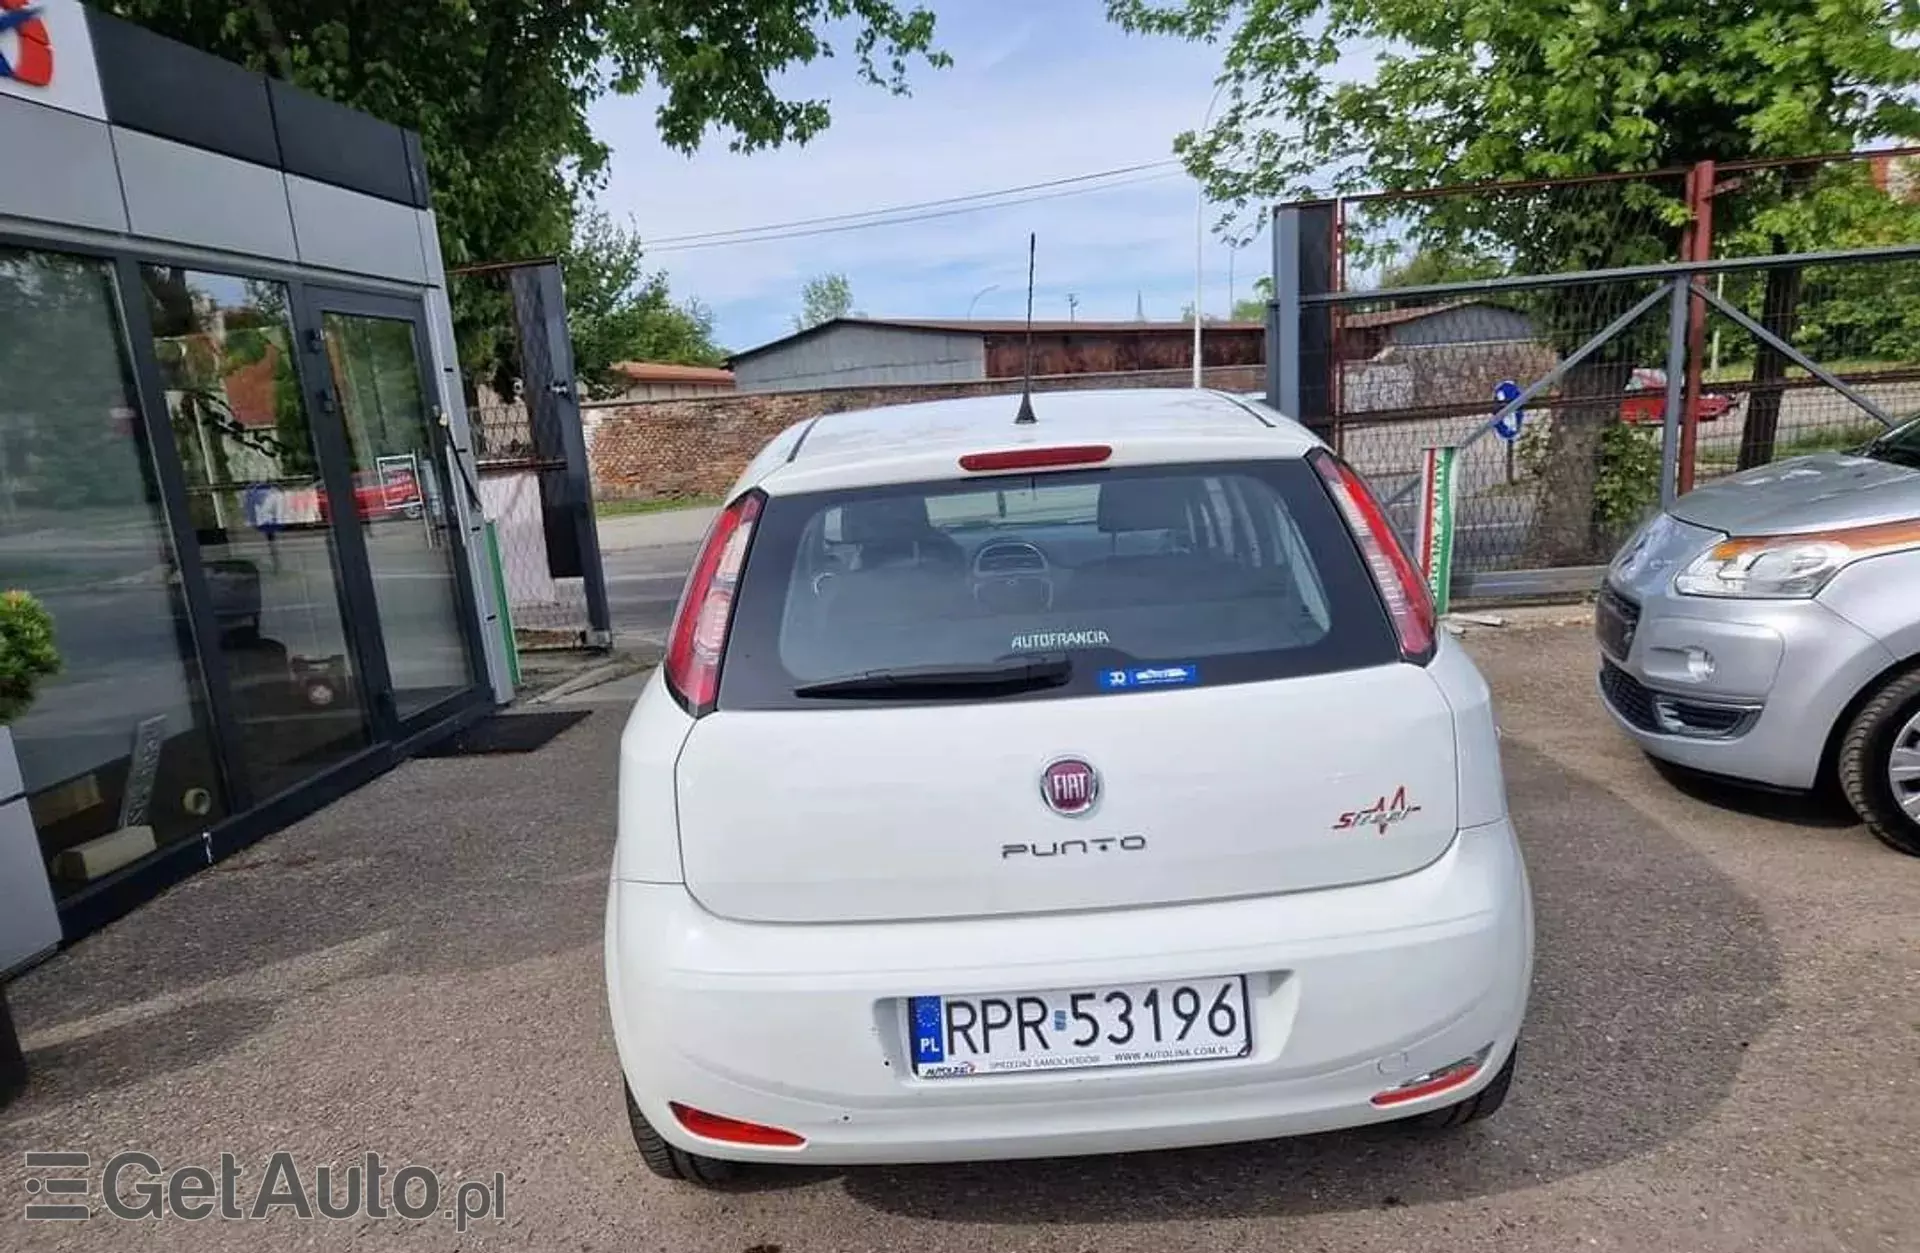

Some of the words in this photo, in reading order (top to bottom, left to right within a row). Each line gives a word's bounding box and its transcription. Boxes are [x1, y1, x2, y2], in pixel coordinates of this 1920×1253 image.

[1011, 631, 1110, 650] AUTOFRANCIA
[1053, 772, 1088, 800] FIAT
[1001, 835, 1147, 859] PUNTO
[945, 997, 1050, 1055] RPR
[1070, 983, 1238, 1048] 53196
[920, 1037, 940, 1054] PL
